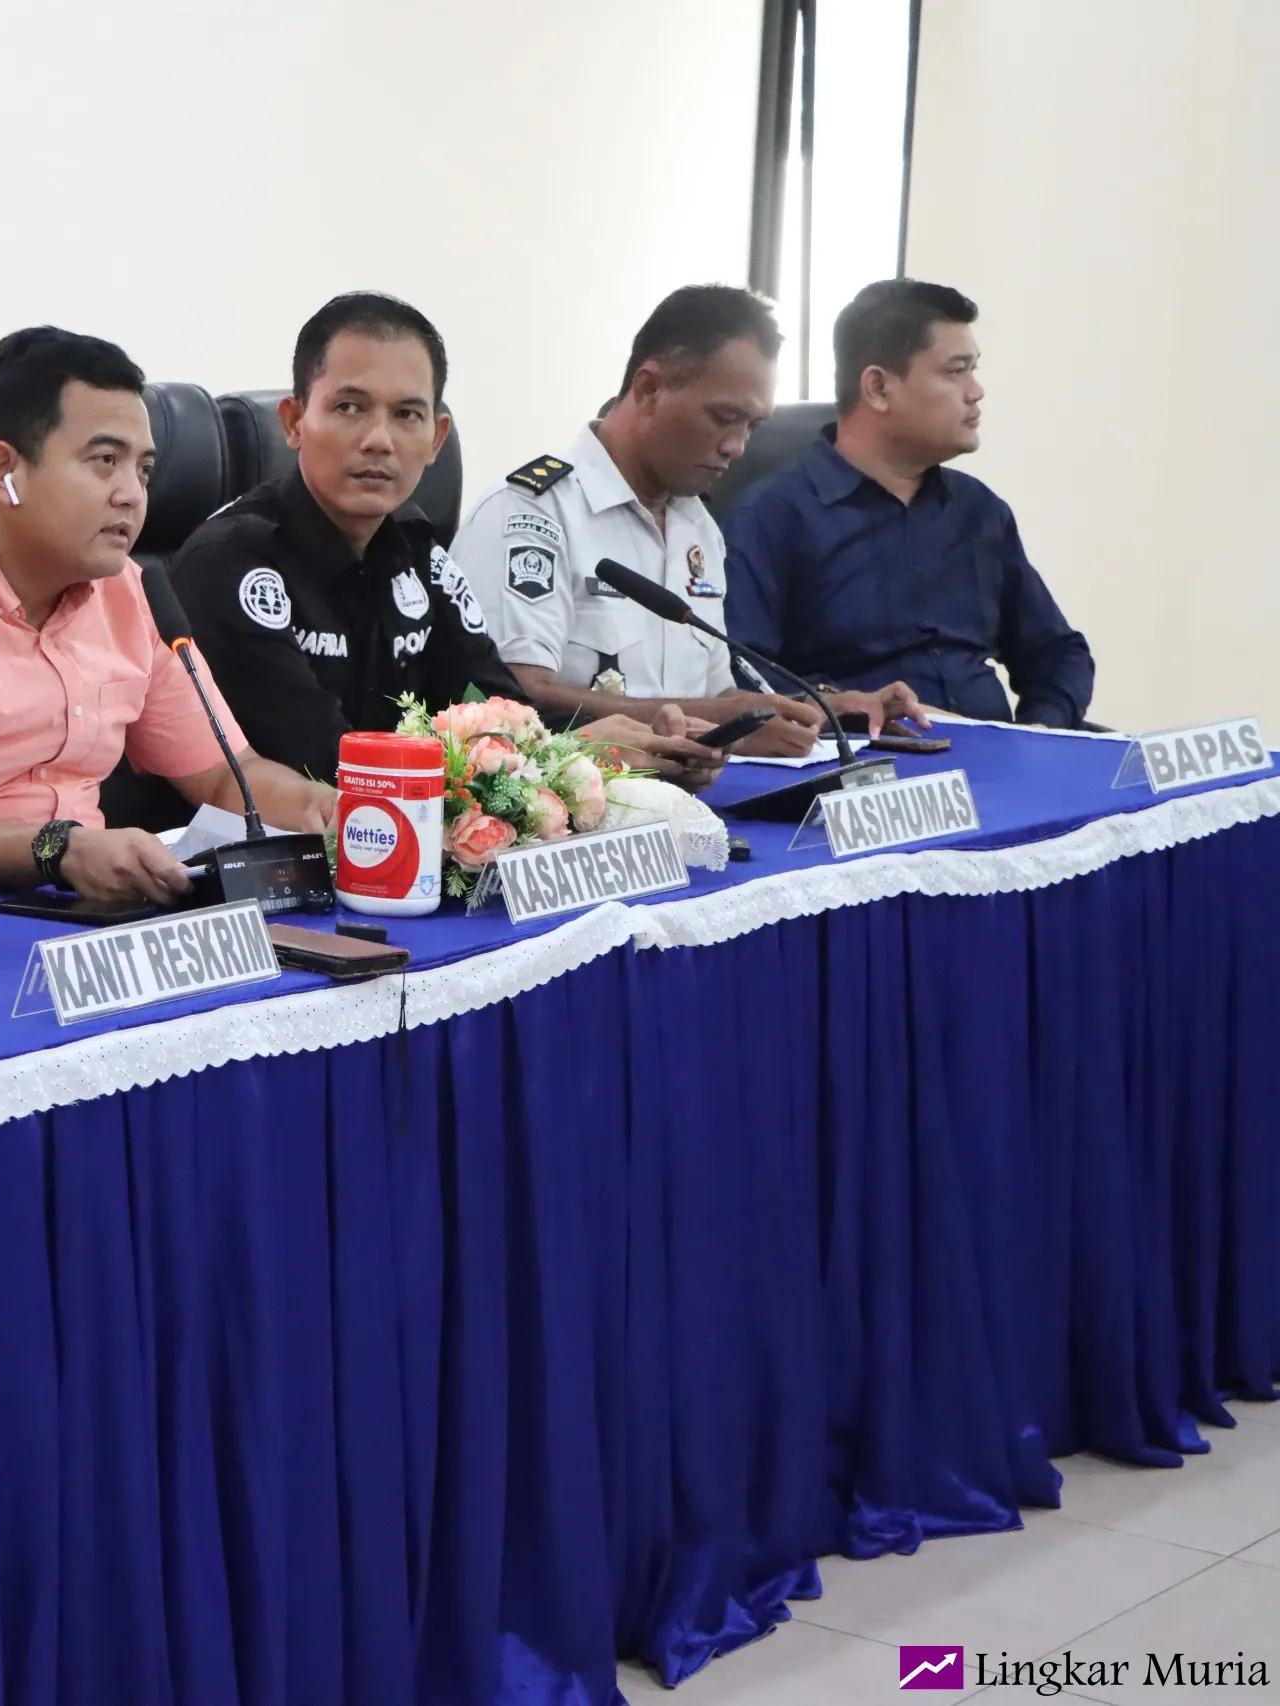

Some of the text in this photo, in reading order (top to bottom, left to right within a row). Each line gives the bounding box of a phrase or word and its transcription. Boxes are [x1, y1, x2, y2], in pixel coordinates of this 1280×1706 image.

[343, 775, 396, 789] GRATIS ISI 50%
[1144, 724, 1265, 785] BAPAS
[346, 825, 395, 846] Wetties
[824, 777, 972, 852] KASIHUMAS
[502, 828, 684, 916] KASATRESKRIM
[46, 910, 273, 1012] KANIT RESKRIM
